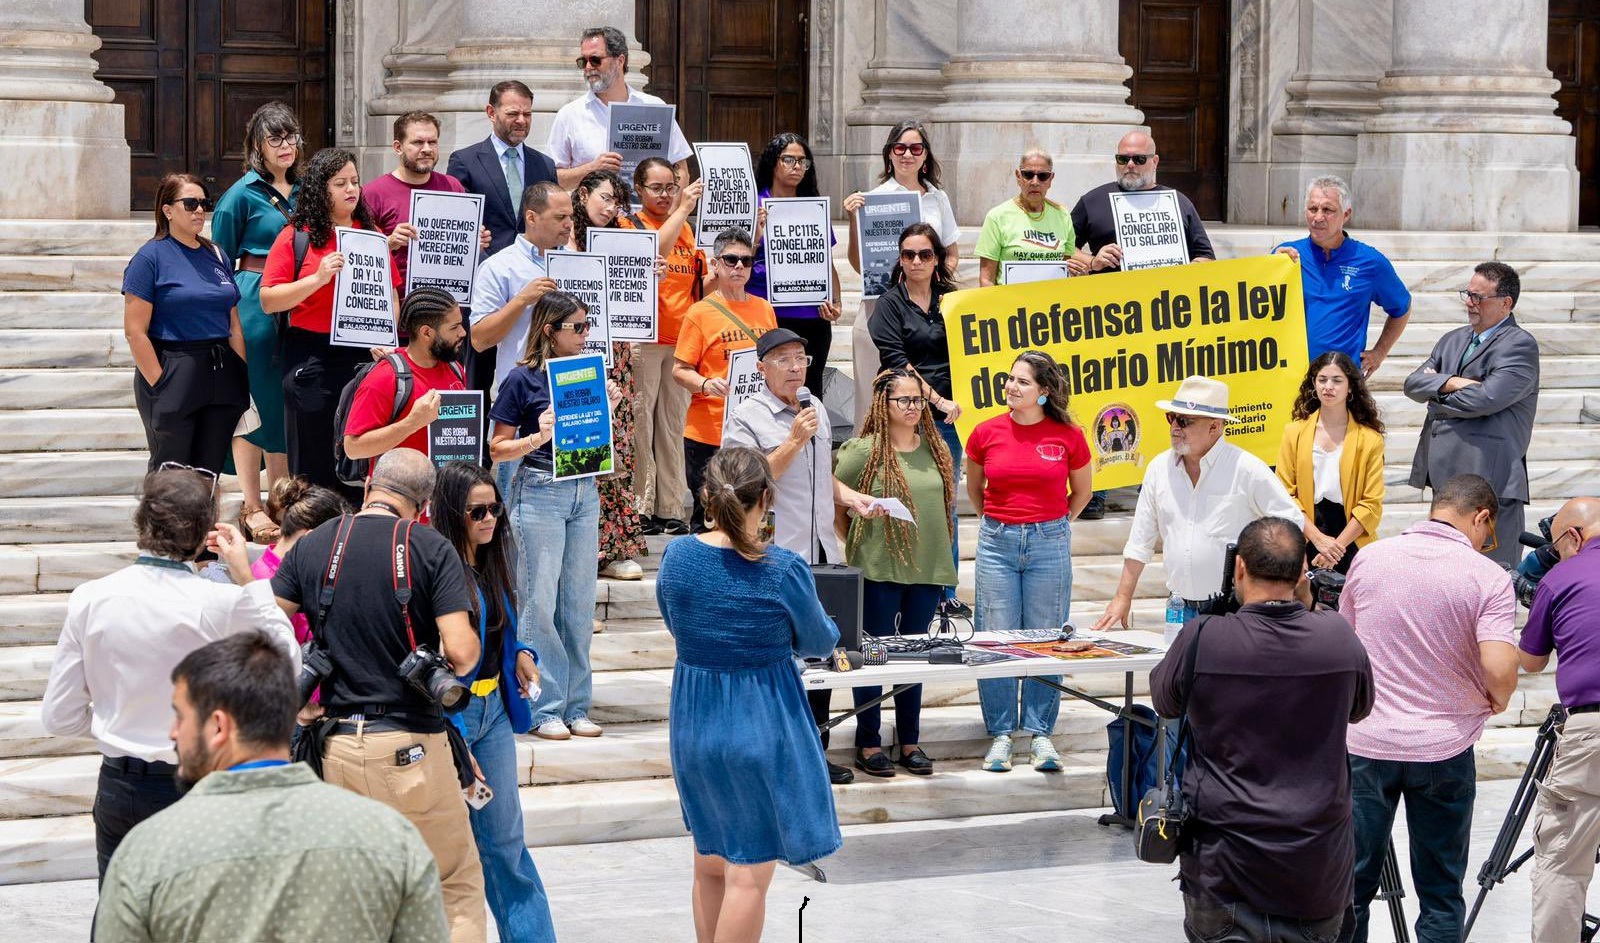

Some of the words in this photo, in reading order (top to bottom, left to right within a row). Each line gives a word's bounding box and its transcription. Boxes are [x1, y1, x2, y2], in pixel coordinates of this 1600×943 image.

[614, 141, 639, 150] NUESTRO
[710, 168, 720, 179] EL
[722, 168, 746, 179] PC1115
[708, 179, 743, 191] EXPULSA
[745, 180, 750, 191] A
[711, 191, 747, 202] NUESTRA
[707, 202, 750, 214] JUVENTUD
[1124, 213, 1137, 223] EL
[418, 218, 429, 228] NO
[431, 218, 475, 232] QUEREMOS
[774, 225, 786, 237] EL
[420, 230, 470, 243] SOBREVIVIR.
[865, 228, 891, 236] NUESTRO
[1123, 237, 1136, 247] TU
[1139, 234, 1178, 246] SALARIO
[419, 242, 469, 255] MERECEMOS
[349, 252, 374, 267] $10.50
[375, 257, 384, 269] NO
[421, 254, 441, 265] VIVIR
[444, 255, 465, 267] BIEN.
[609, 256, 652, 267] QUEREMOS
[772, 252, 784, 265] TU
[786, 252, 825, 264] SALARIO
[353, 268, 364, 280] DA
[366, 270, 372, 281] Y
[373, 271, 383, 282] LO
[609, 267, 648, 279] BREVIVIR.
[351, 282, 384, 297] QUIEREN
[563, 280, 603, 291] QUEREMOS
[609, 280, 648, 290] RECEMOS
[624, 292, 645, 303] BIEN.
[346, 296, 388, 312] CONGELAR
[961, 313, 1001, 356] En
[1008, 300, 1143, 350] defensa
[1151, 290, 1191, 331] de
[1199, 286, 1230, 325] la
[1237, 281, 1287, 321] ley
[971, 367, 1010, 409] de
[1061, 349, 1148, 396] lario
[1156, 336, 1287, 383] Mínimo.
[738, 374, 748, 384] EL
[735, 384, 746, 395] NO
[1228, 402, 1272, 414] vimiento
[1225, 424, 1265, 436] Sindical
[396, 544, 405, 578] Canon
